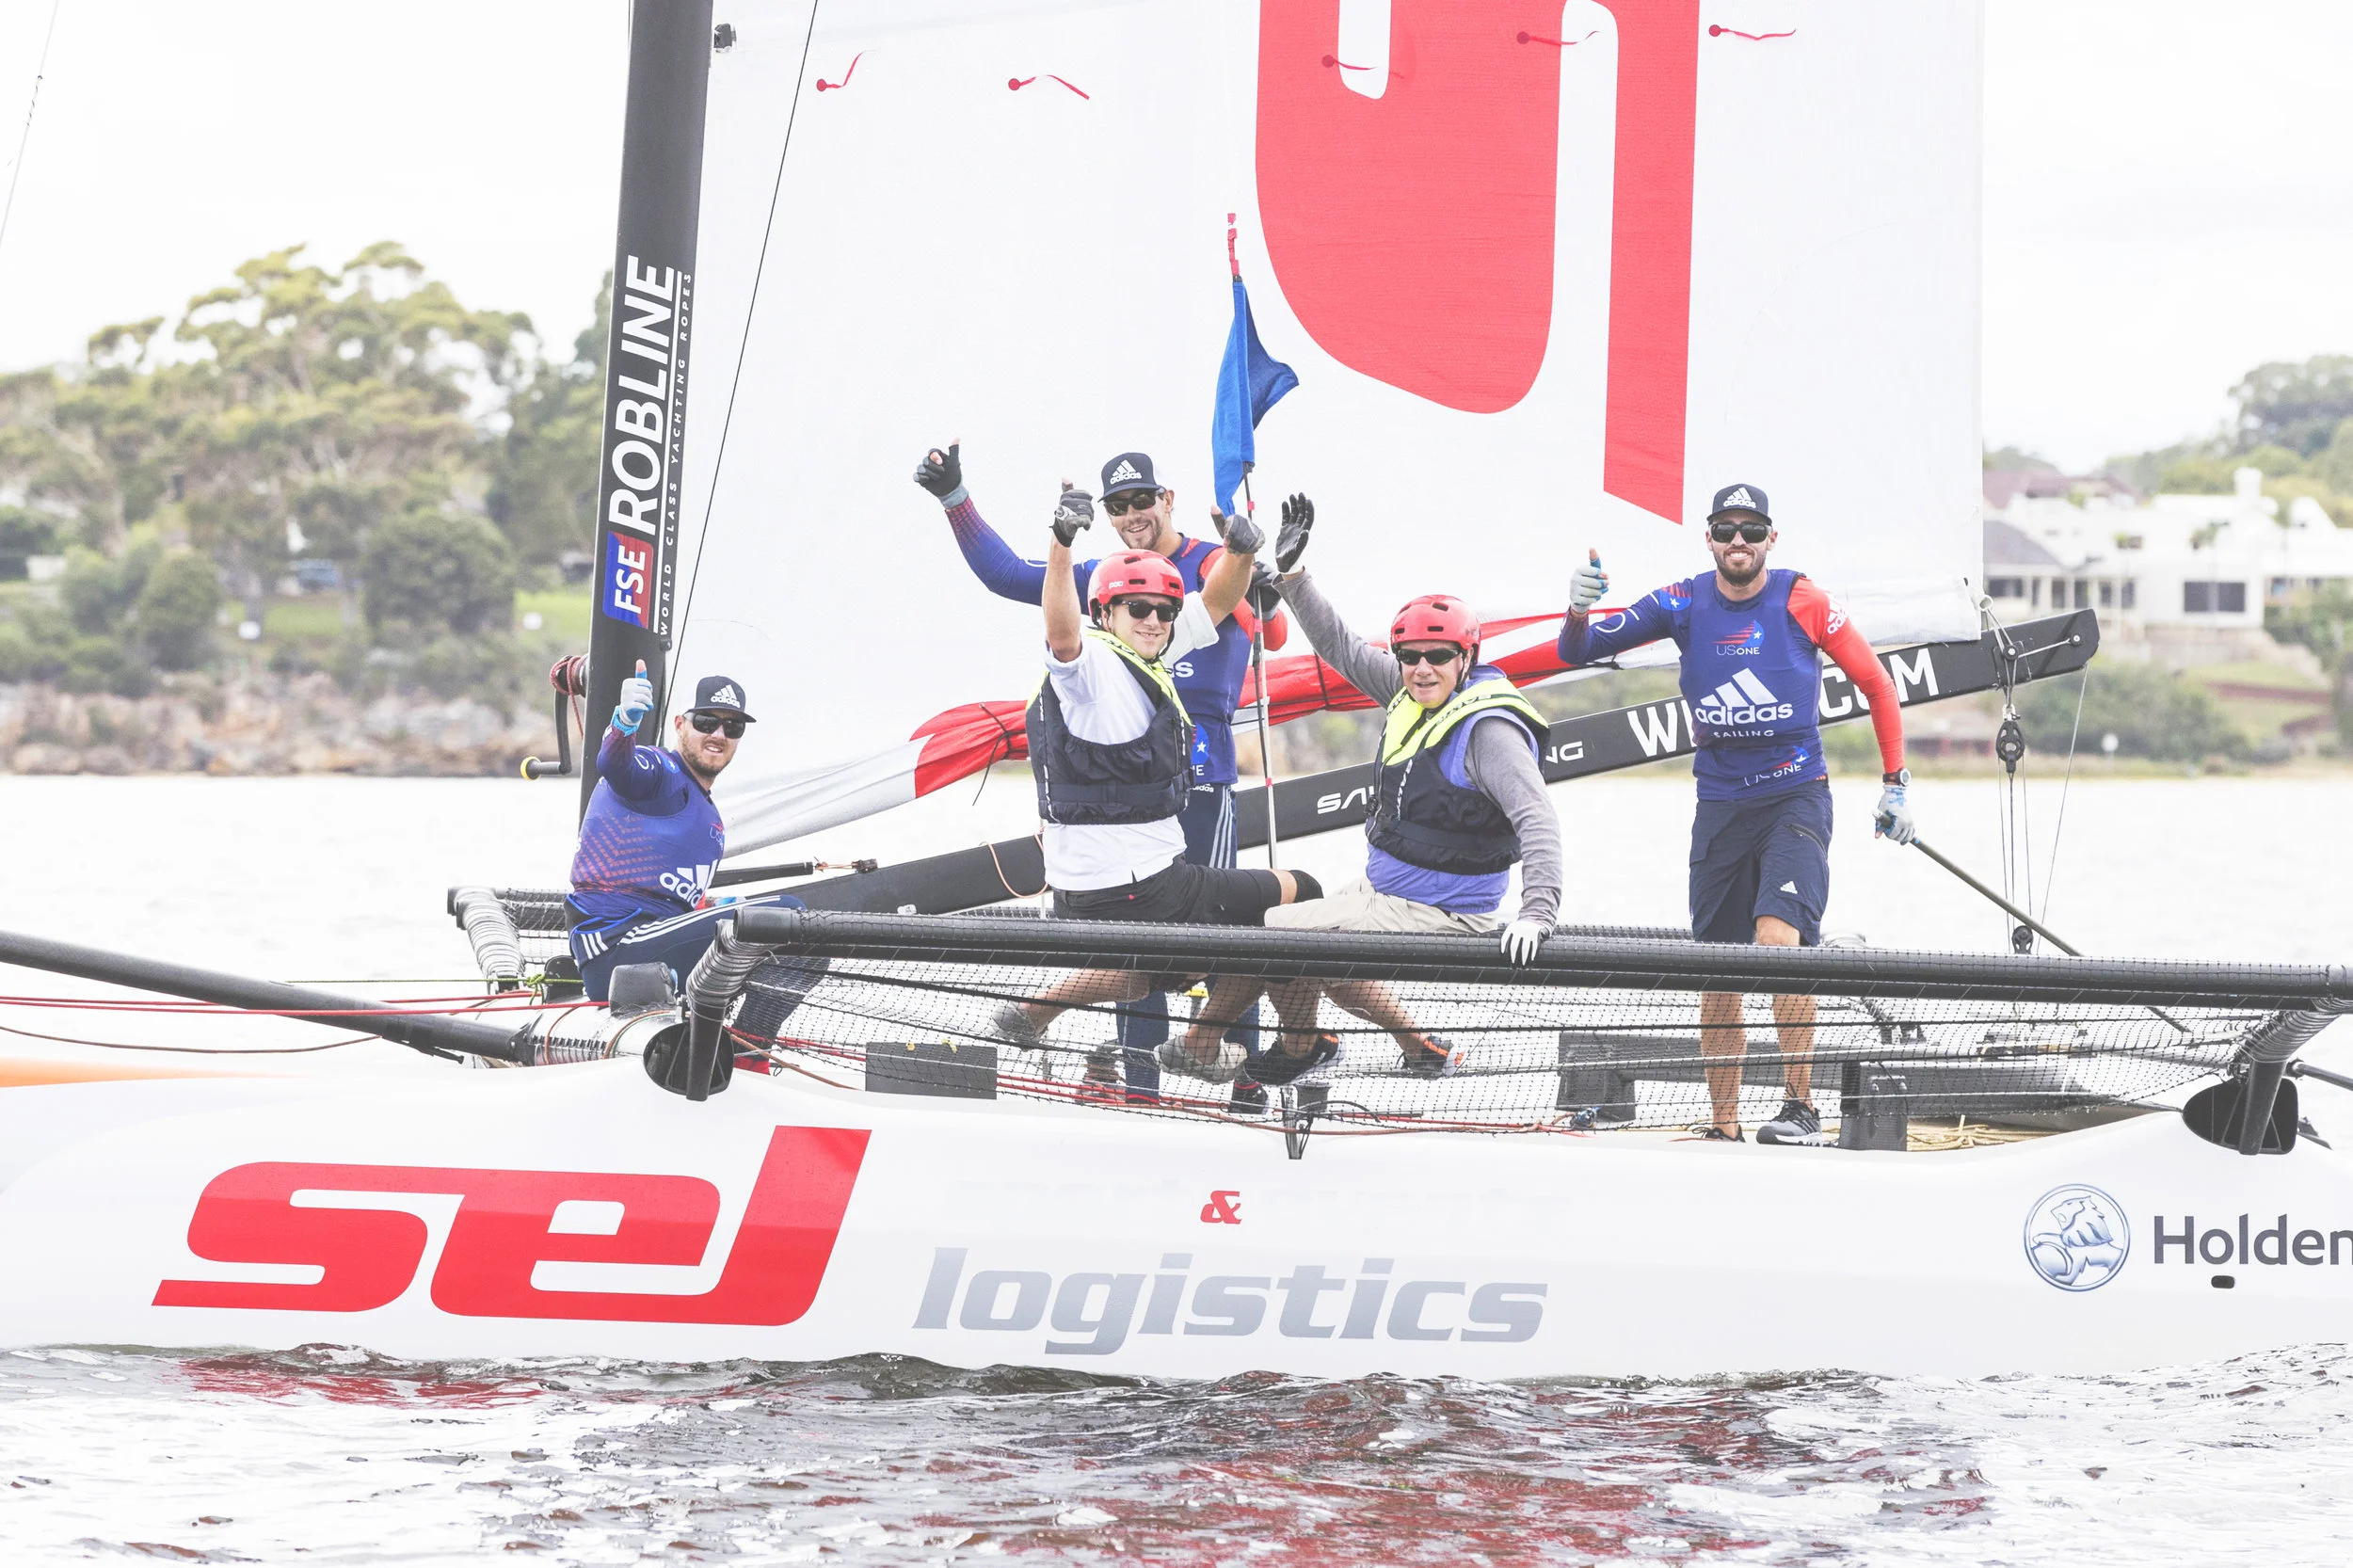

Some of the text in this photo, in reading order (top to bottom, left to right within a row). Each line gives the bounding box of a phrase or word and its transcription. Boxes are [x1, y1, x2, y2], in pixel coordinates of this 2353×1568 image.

[608, 255, 675, 615] FSE ROBLINE
[660, 274, 692, 636] WORLD CLASS YACHTING ROPES
[1110, 472, 1143, 485] adidas
[1723, 499, 1757, 509] adidas
[710, 695, 741, 709] adidas
[1694, 703, 1794, 727] adidas
[1713, 729, 1775, 738] SAILING
[1200, 1190, 1242, 1225] &
[2153, 1212, 2353, 1266] Holden
[911, 1247, 1548, 1355] logistics
